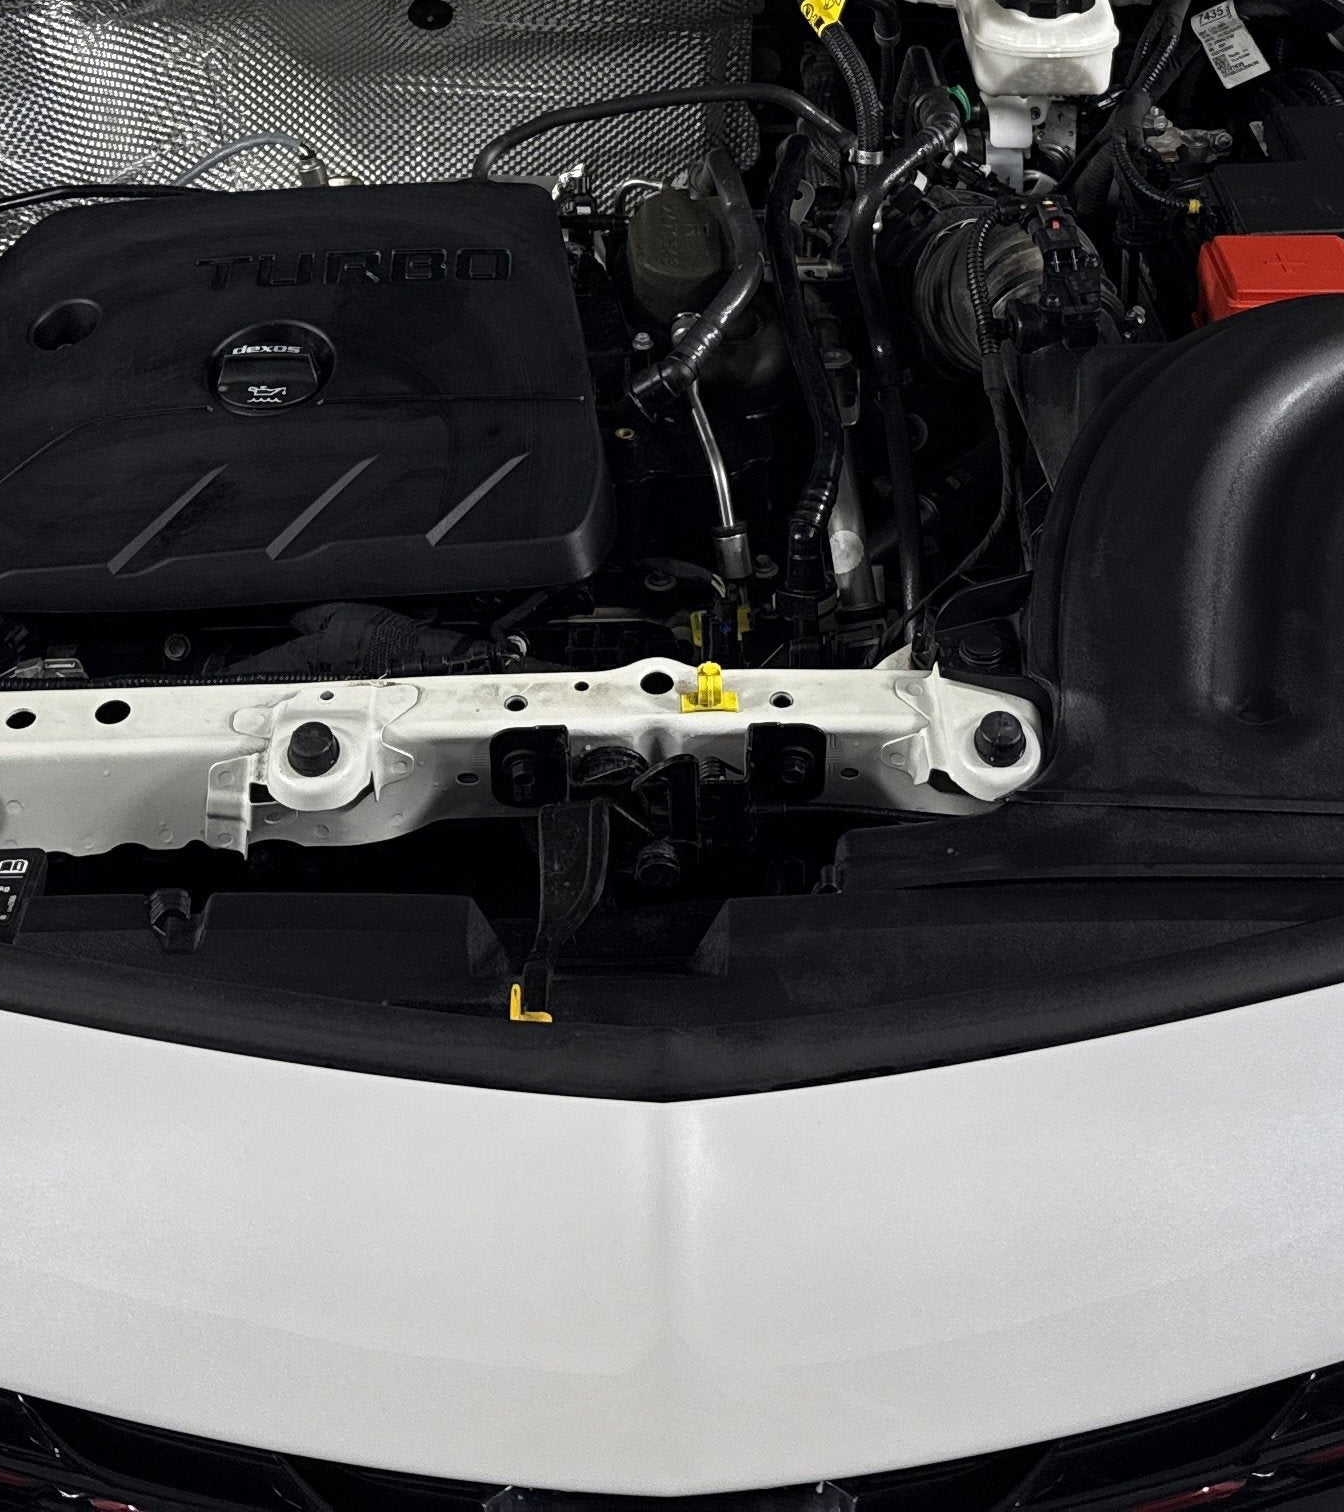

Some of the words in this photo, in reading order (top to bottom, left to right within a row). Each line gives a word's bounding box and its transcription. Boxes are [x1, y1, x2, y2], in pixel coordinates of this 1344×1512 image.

[1199, 6, 1224, 24] 7435
[196, 248, 513, 288] TURBO
[232, 344, 303, 355] dexos
